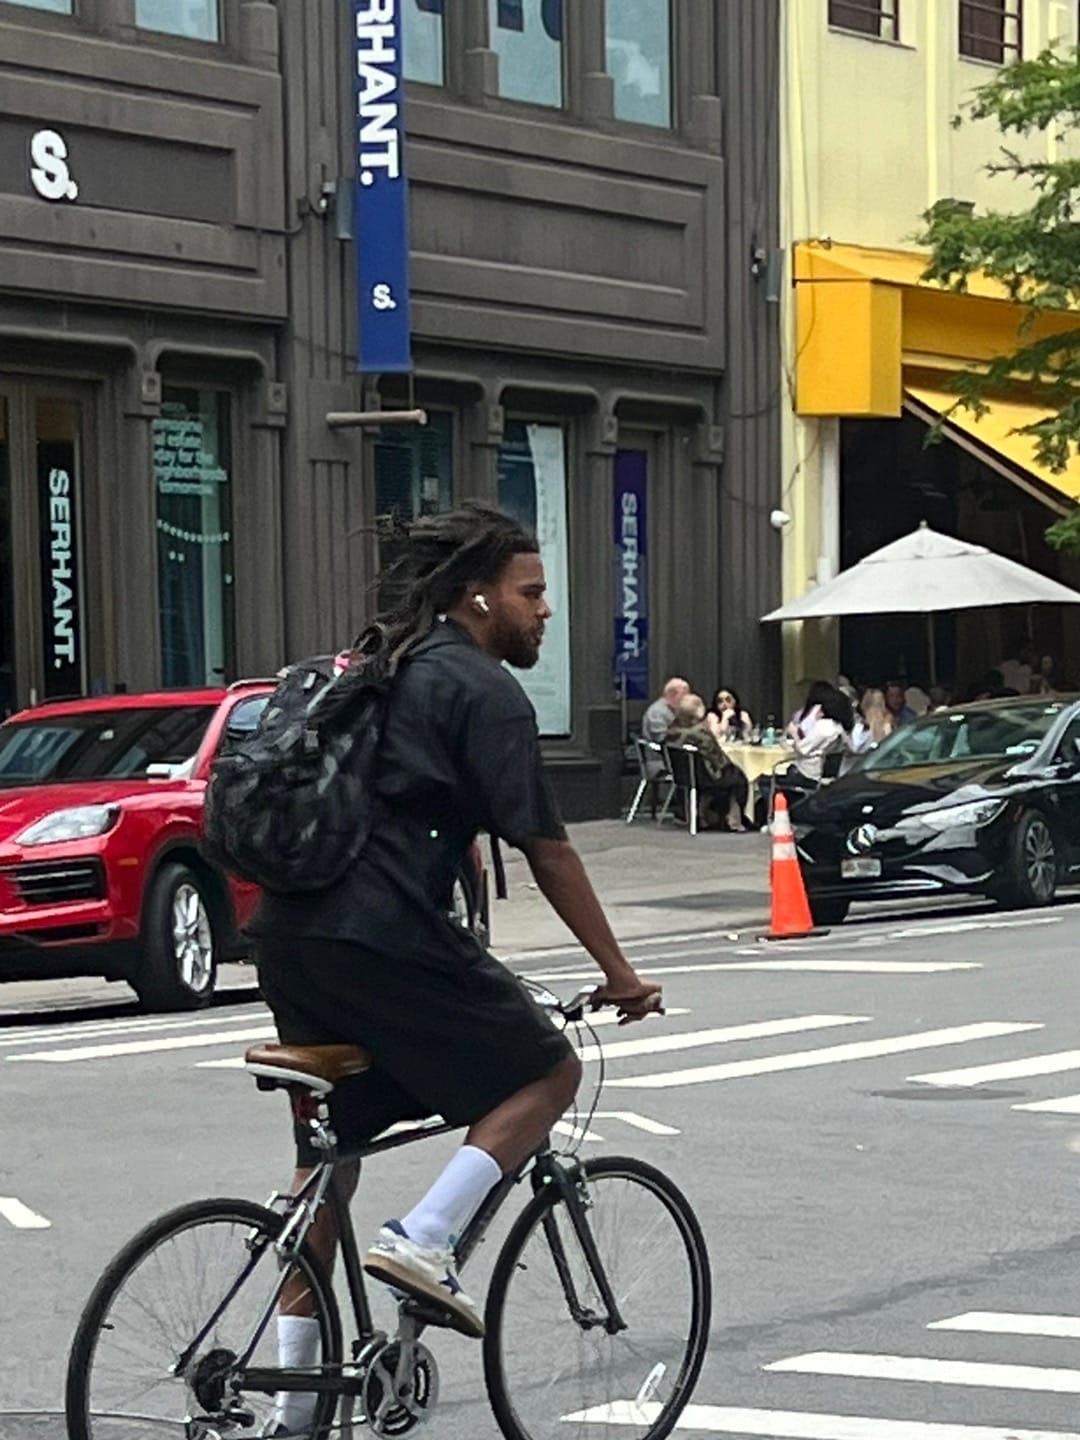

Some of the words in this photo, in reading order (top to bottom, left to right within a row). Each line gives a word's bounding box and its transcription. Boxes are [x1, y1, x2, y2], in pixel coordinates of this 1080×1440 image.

[31, 130, 78, 200] S.
[373, 284, 397, 310] S.
[49, 468, 75, 669] SERHANT.
